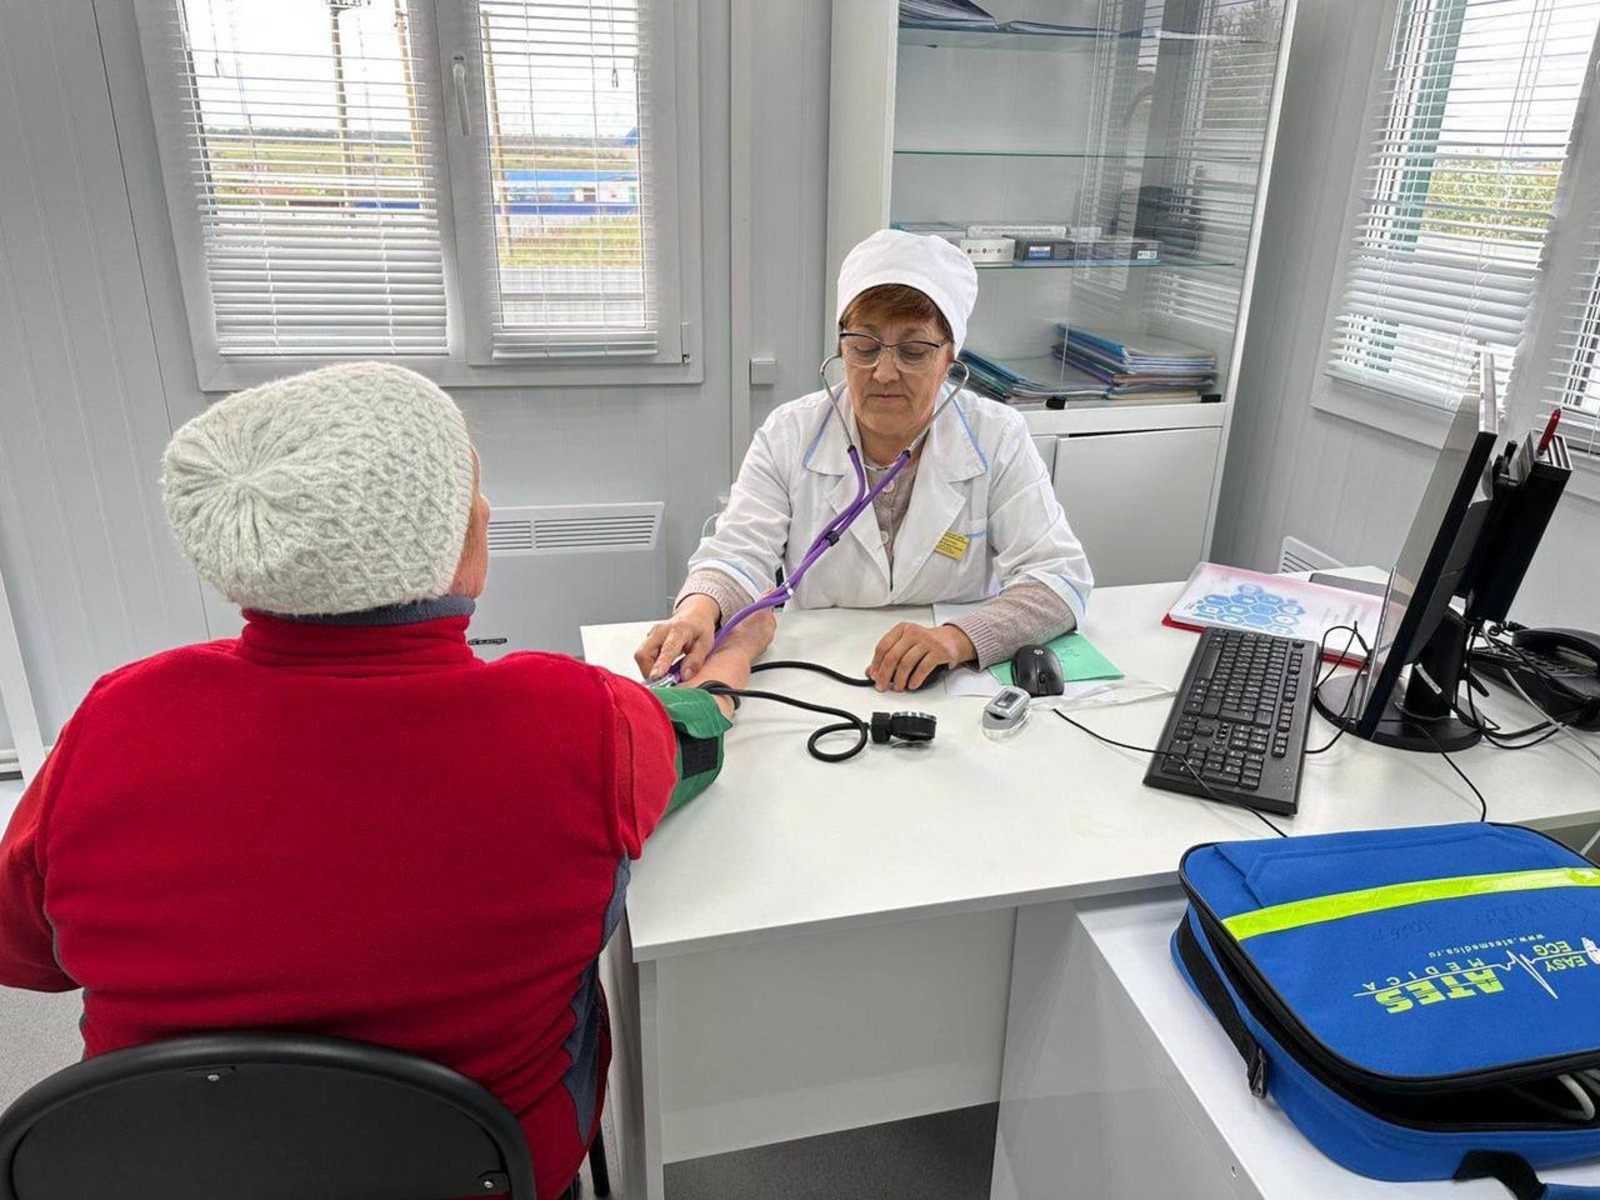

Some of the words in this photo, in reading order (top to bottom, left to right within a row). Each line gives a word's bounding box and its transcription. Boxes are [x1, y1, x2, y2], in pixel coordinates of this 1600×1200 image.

[1533, 940, 1573, 956] ECG
[1362, 957, 1486, 991] MEDICA
[1544, 955, 1588, 972] EASY
[1375, 967, 1504, 1014] ATES
